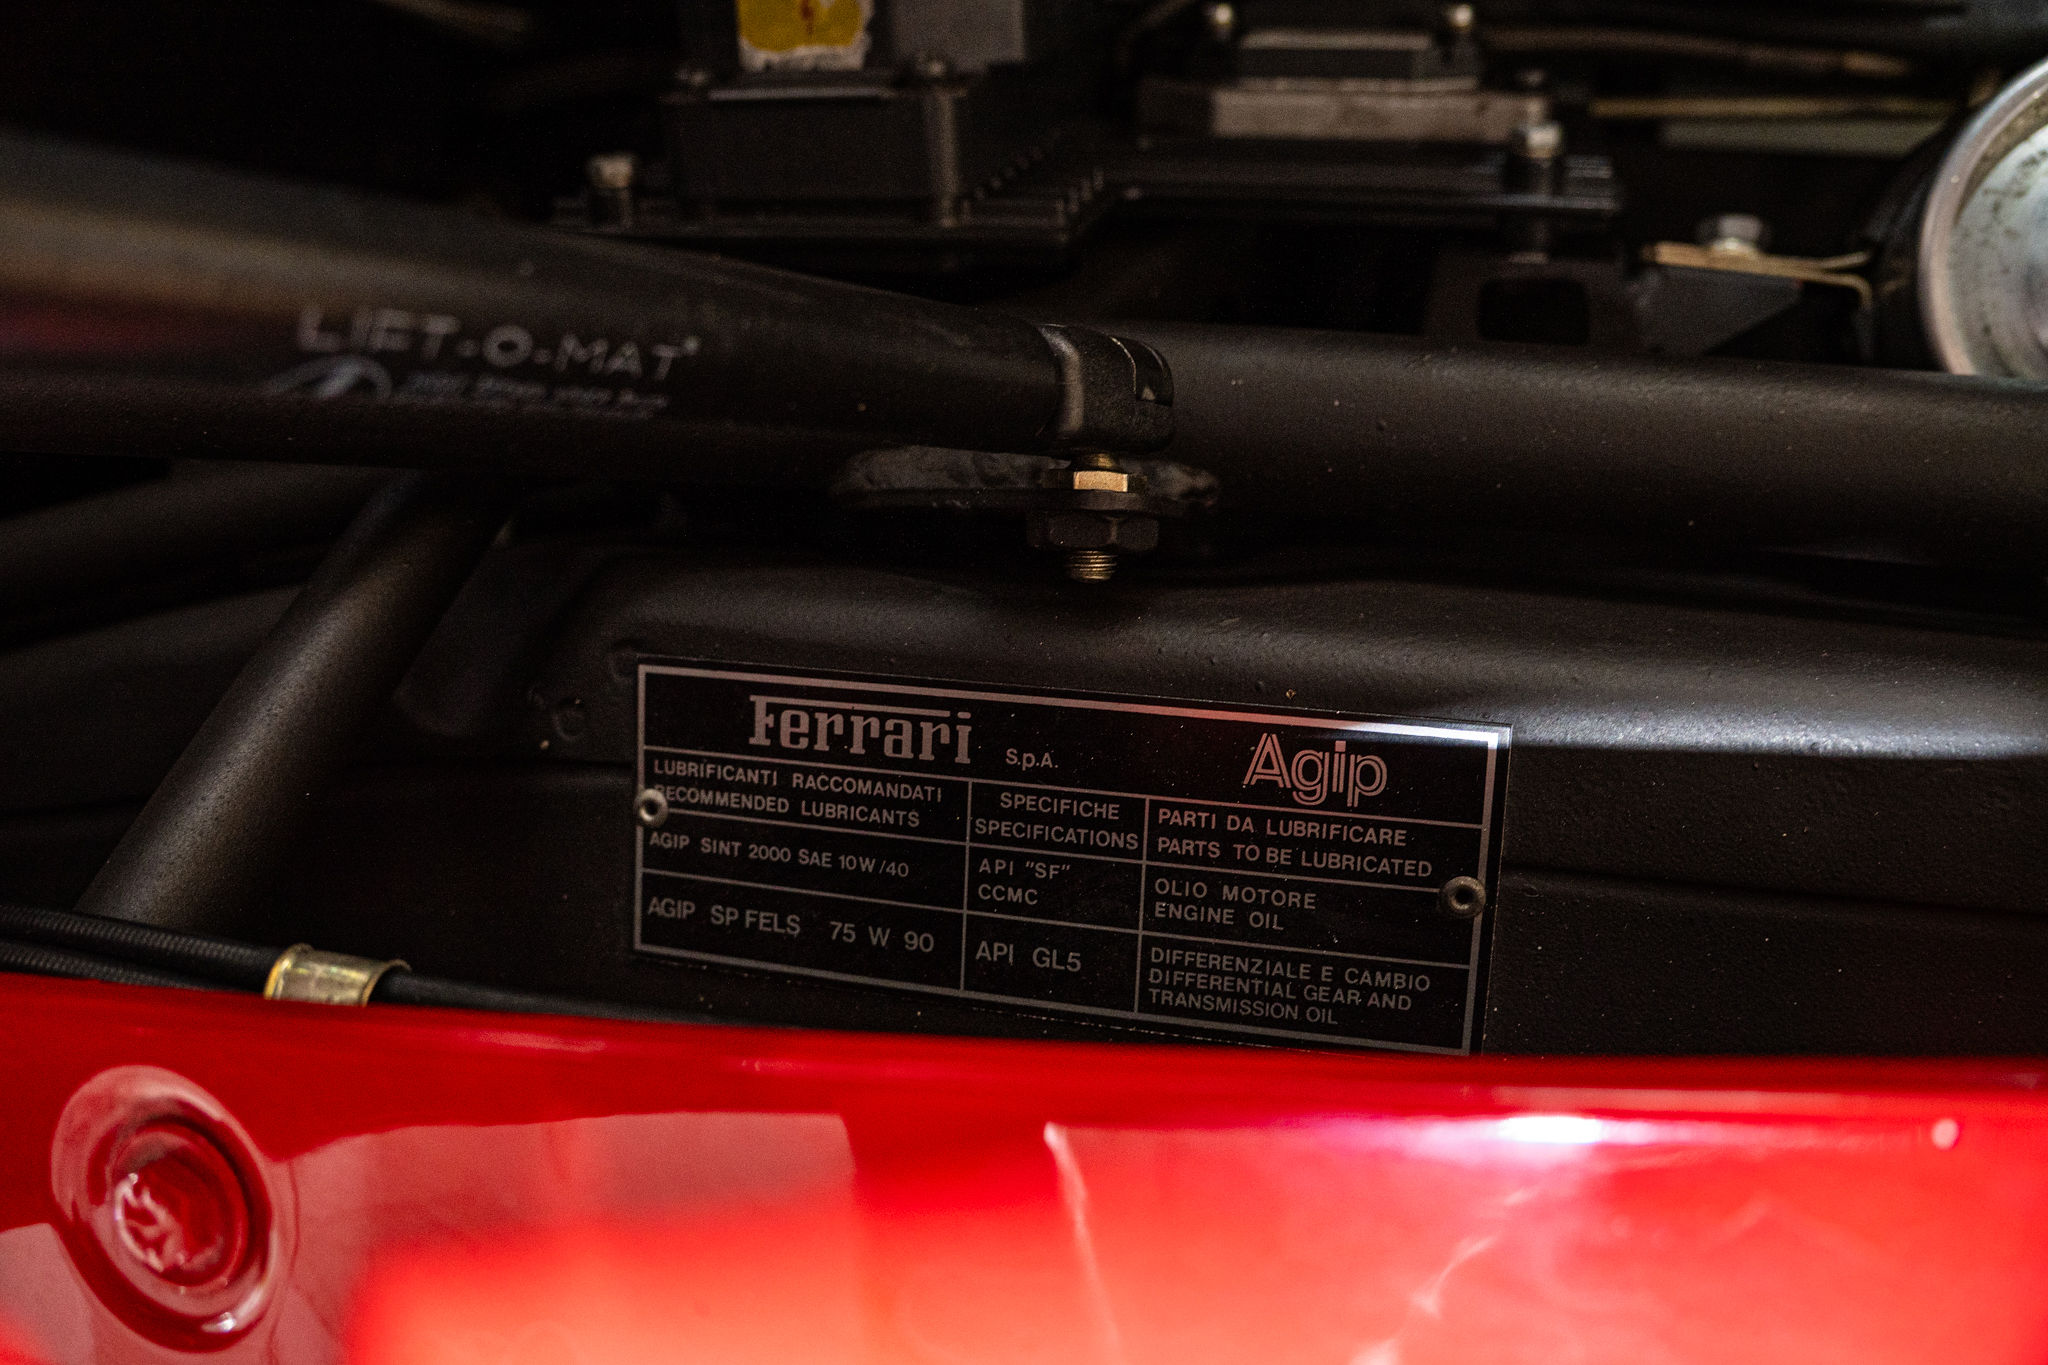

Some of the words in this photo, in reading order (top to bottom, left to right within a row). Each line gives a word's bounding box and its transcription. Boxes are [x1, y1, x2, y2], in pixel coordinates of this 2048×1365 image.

[749, 695, 972, 764] Ferrari
[654, 759, 778, 786] LUBRIFICANTI
[792, 773, 942, 802] RACCOMANDATI
[1243, 733, 1388, 807] Agip
[801, 800, 920, 828] LUBRICANTS
[1000, 792, 1120, 821] SPECIFICHE
[974, 819, 1139, 850] SPECIFICATIONS
[1158, 808, 1216, 829] PARTI
[1227, 814, 1254, 832] DA
[1267, 819, 1408, 847] LUBRIFICARE
[650, 831, 690, 850] AGIP
[700, 838, 741, 857] SINT
[748, 846, 791, 863] 2000
[798, 849, 832, 868] SAE
[979, 858, 1014, 876] API
[1158, 838, 1220, 858] PARTS
[1233, 844, 1260, 862] TO
[1267, 848, 1292, 866] BE
[1302, 851, 1432, 878] LUBRICATED
[978, 883, 1039, 905] CCMC
[1155, 878, 1208, 899] OLIO
[1222, 886, 1317, 909] MOTORE
[648, 896, 696, 920] AGIP
[829, 921, 856, 943] 75
[868, 925, 891, 946] W
[904, 931, 934, 952] 90
[1154, 902, 1235, 926] ENGINE
[1249, 911, 1284, 930] OIL
[976, 940, 1015, 966] API
[1032, 947, 1081, 972] GL5
[1152, 948, 1311, 980] DIFFERENZIALE
[1321, 966, 1333, 982] E
[1345, 968, 1430, 992] CAMBIO
[1149, 989, 1298, 1020] TRANSMISSION
[1306, 1006, 1338, 1025] OIL
[1150, 968, 1296, 1000] DIFFERENTIAL
[1304, 985, 1361, 1004] GEAR
[1367, 991, 1412, 1011] AND
